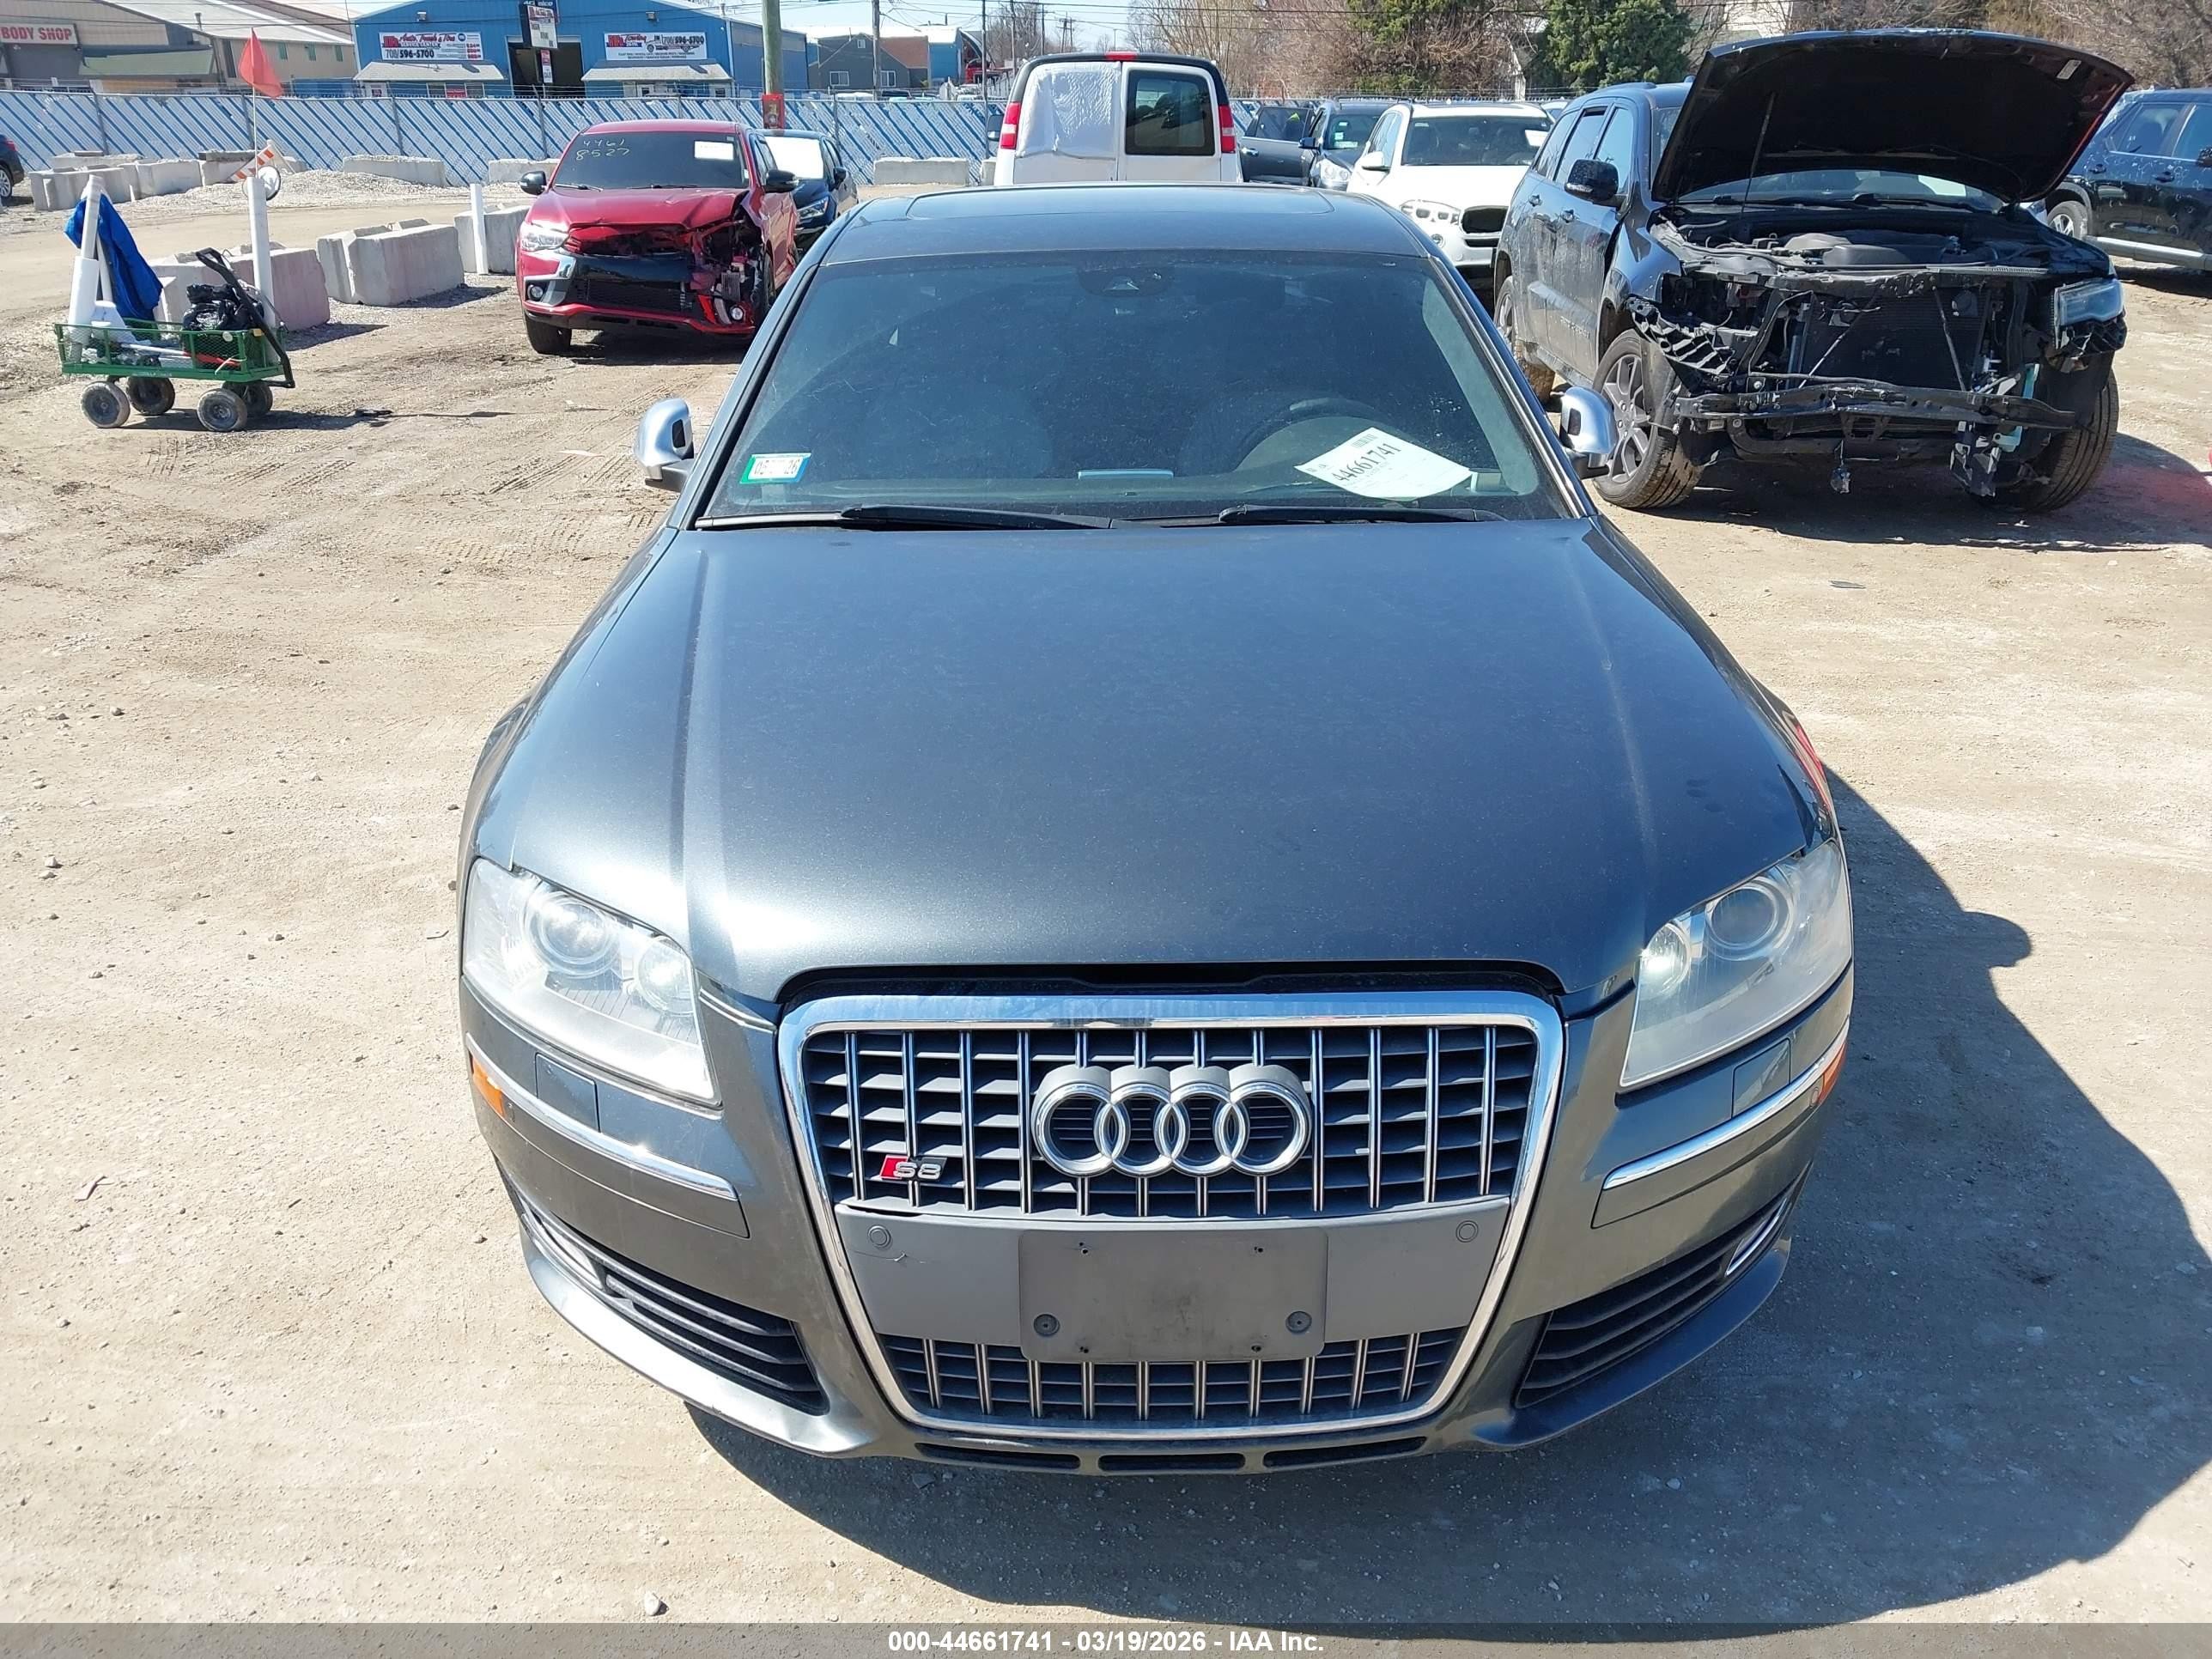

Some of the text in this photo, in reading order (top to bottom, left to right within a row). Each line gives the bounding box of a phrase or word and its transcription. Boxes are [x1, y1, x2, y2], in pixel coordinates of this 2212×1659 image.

[1, 27, 72, 40] BODY SHOP
[575, 148, 630, 161] 8527
[1332, 443, 1401, 481] 44661741
[893, 1161, 941, 1180] S8
